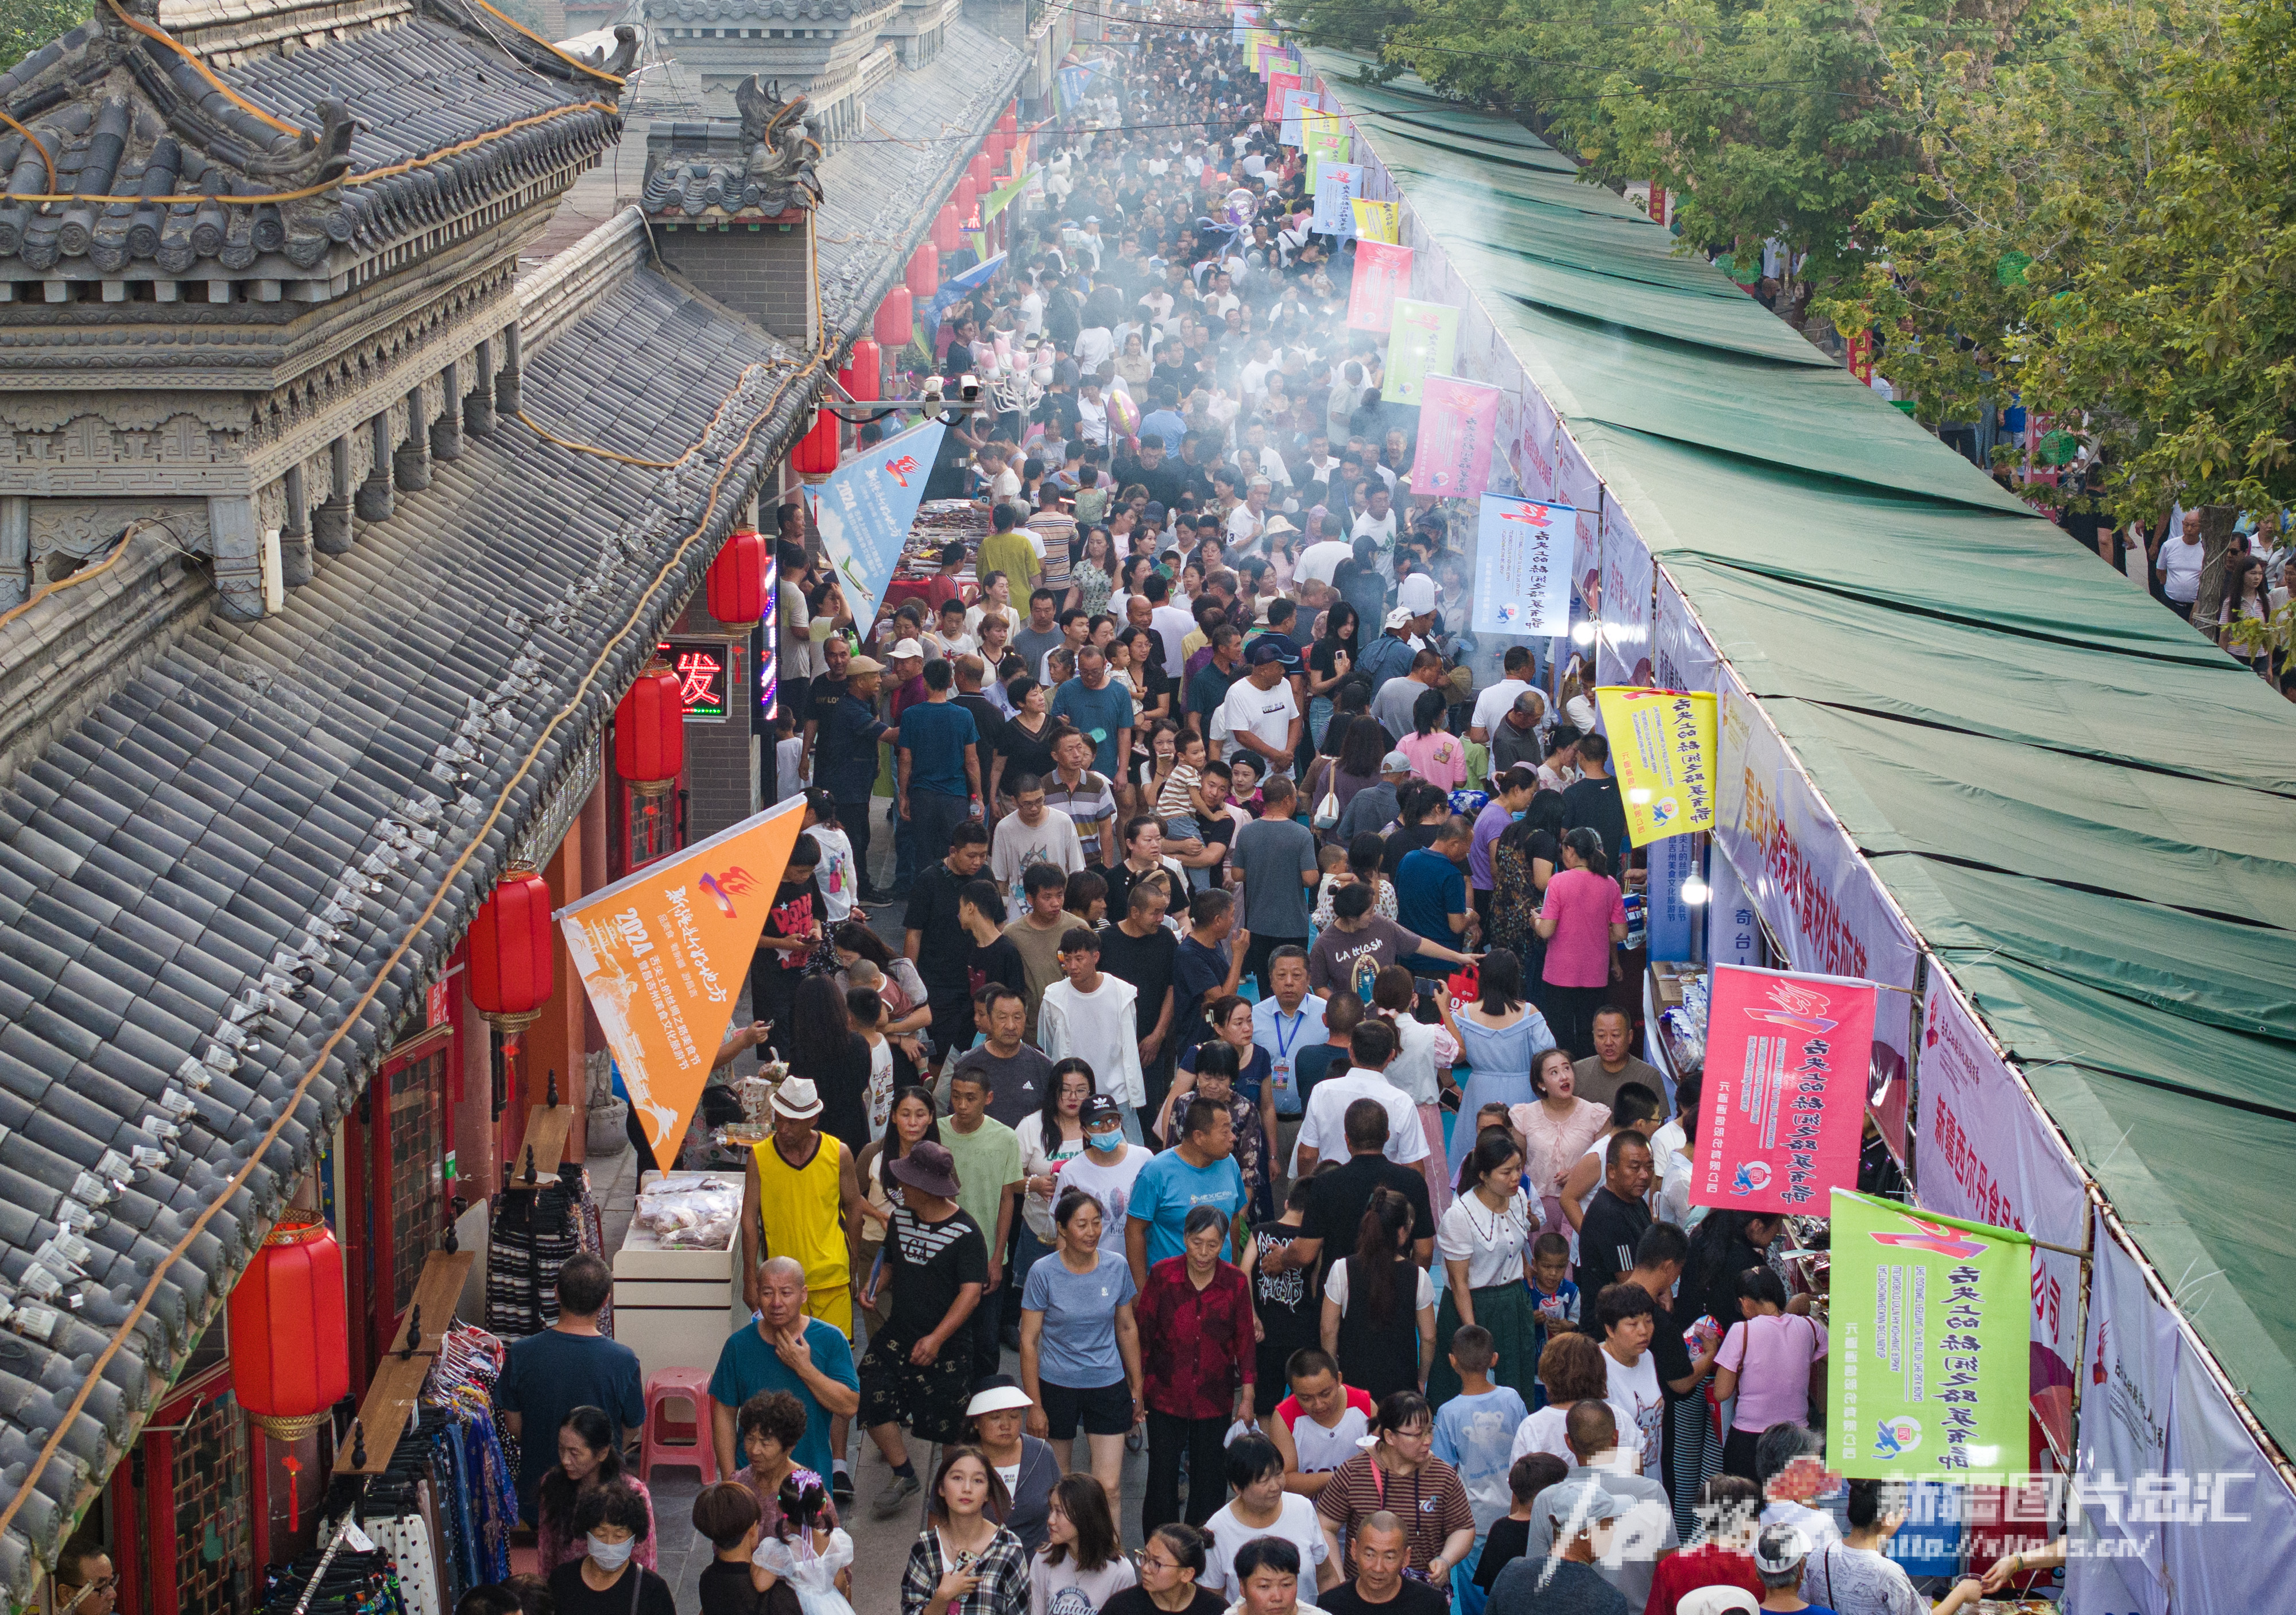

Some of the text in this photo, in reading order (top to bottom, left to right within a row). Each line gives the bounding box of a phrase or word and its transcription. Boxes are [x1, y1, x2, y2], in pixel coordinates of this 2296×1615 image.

[836, 480, 857, 511] 2024
[1229, 533, 1235, 542] 3
[679, 653, 721, 704] 发
[615, 907, 655, 959] 2024
[649, 954, 702, 1066] 舌尖上的丝绸之路美食节
[1934, 1092, 2061, 1345] 新疆西尔丹食品公司
